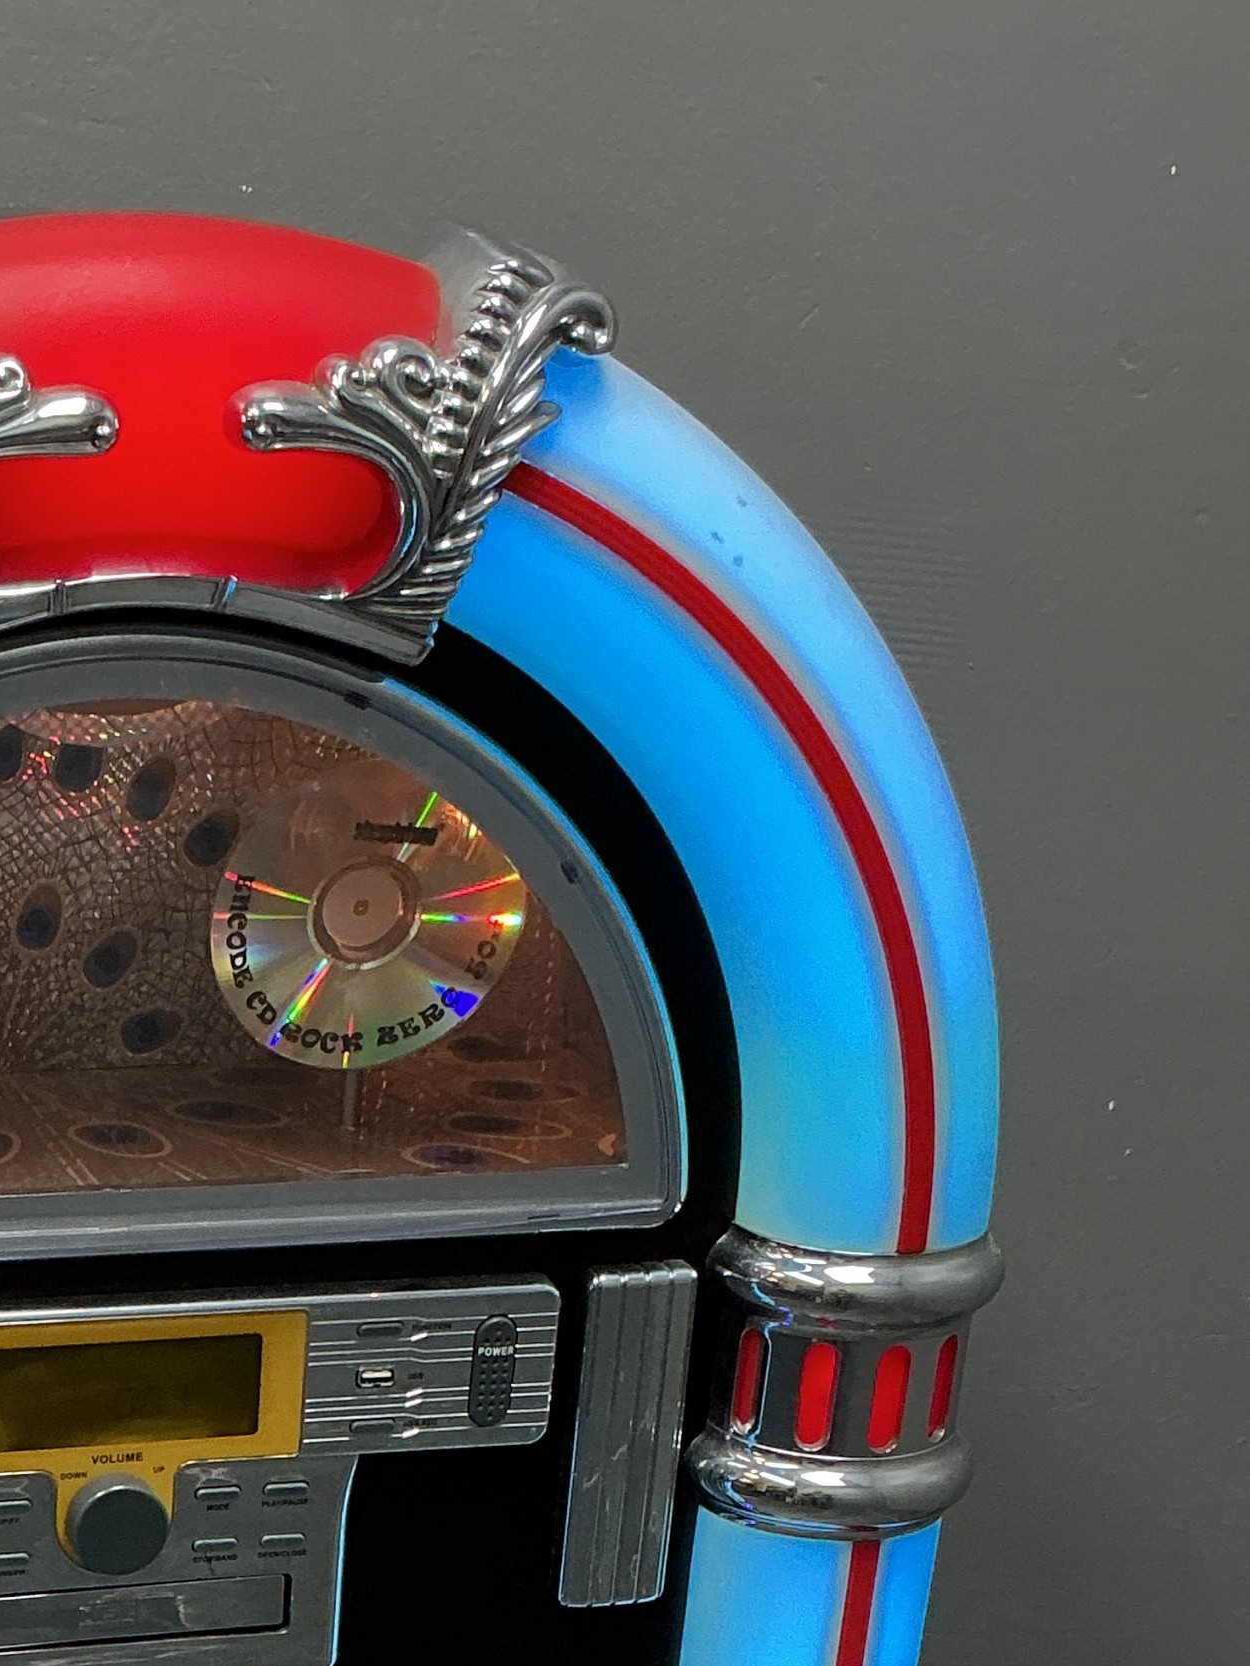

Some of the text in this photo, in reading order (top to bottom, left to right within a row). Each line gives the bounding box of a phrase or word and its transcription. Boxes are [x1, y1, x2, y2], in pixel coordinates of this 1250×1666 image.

[246, 991, 277, 1025] CD
[280, 1021, 364, 1054] ROCK
[377, 987, 459, 1046] ZERO
[478, 1346, 514, 1356] POWER
[91, 1452, 144, 1465] VOLUME
[152, 1465, 166, 1474] UP
[60, 1471, 88, 1481] DOWN
[207, 1502, 230, 1512] MODE
